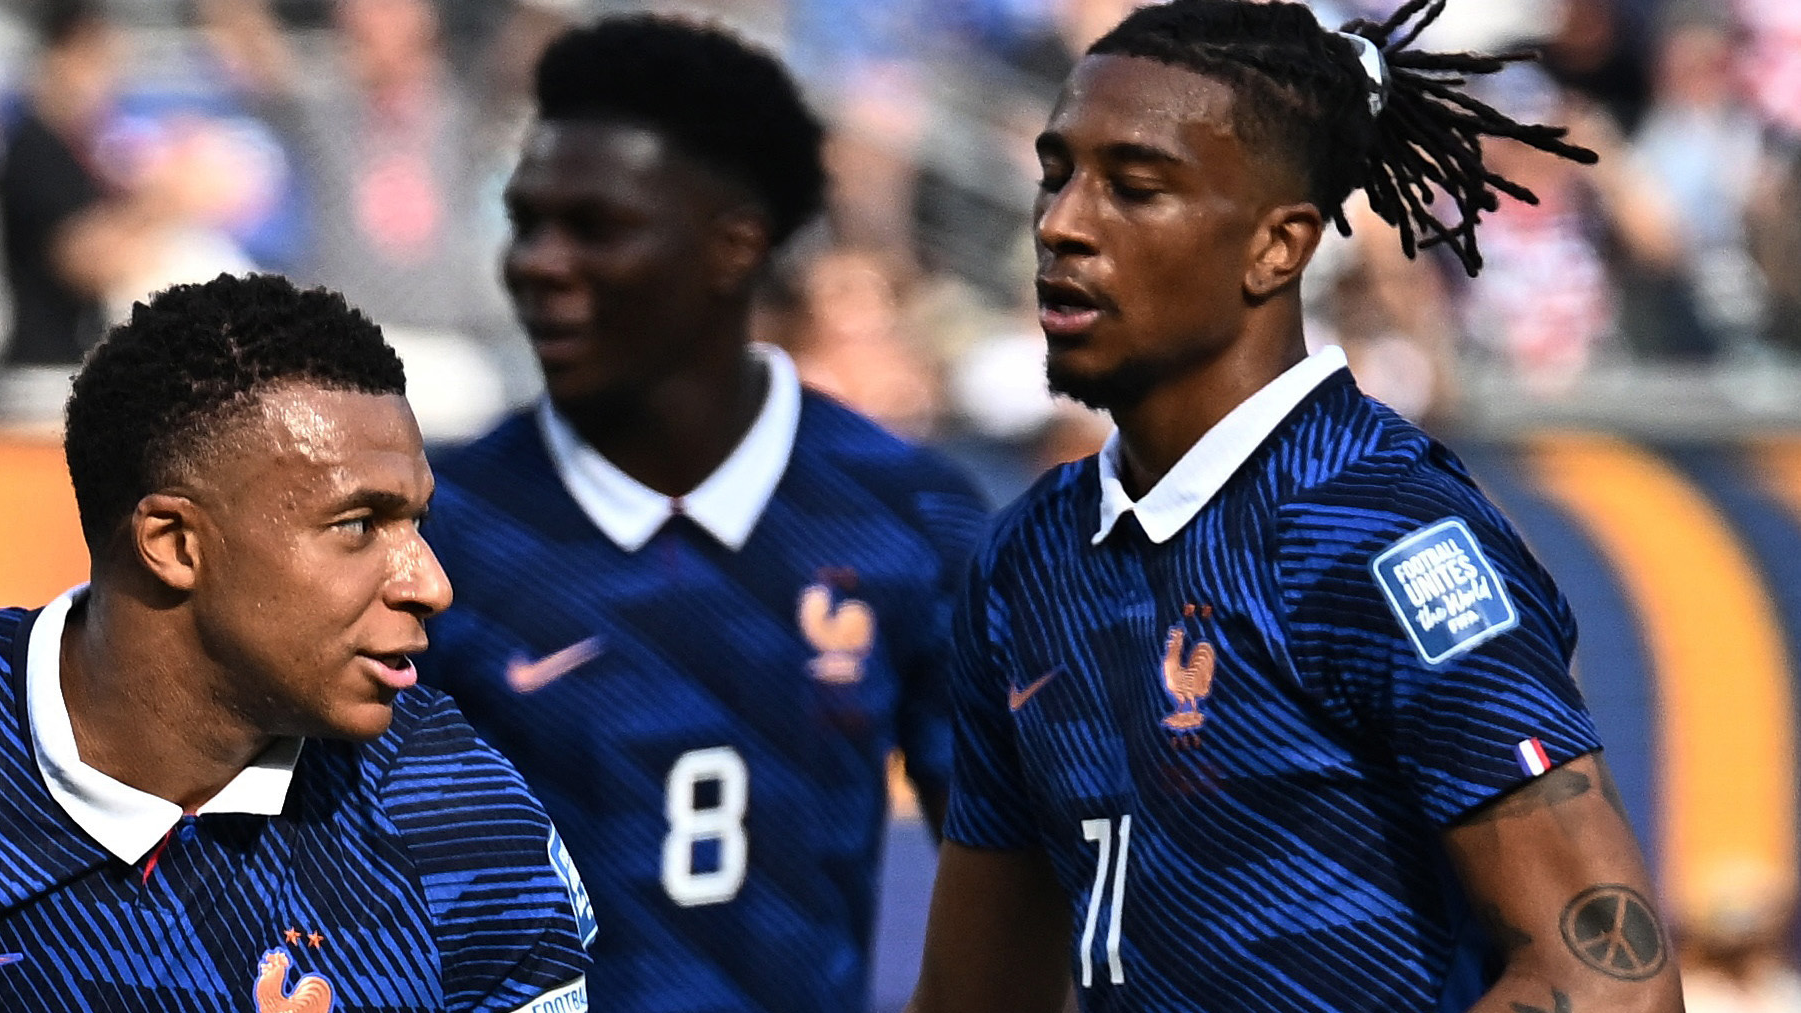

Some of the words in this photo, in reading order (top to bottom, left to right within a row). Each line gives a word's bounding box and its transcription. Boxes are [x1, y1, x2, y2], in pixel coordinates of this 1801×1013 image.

[1393, 538, 1465, 583] FOOTBALL
[1403, 554, 1478, 608] UNITES
[1415, 603, 1447, 632] the
[1441, 575, 1493, 616] World
[660, 746, 749, 908] 8
